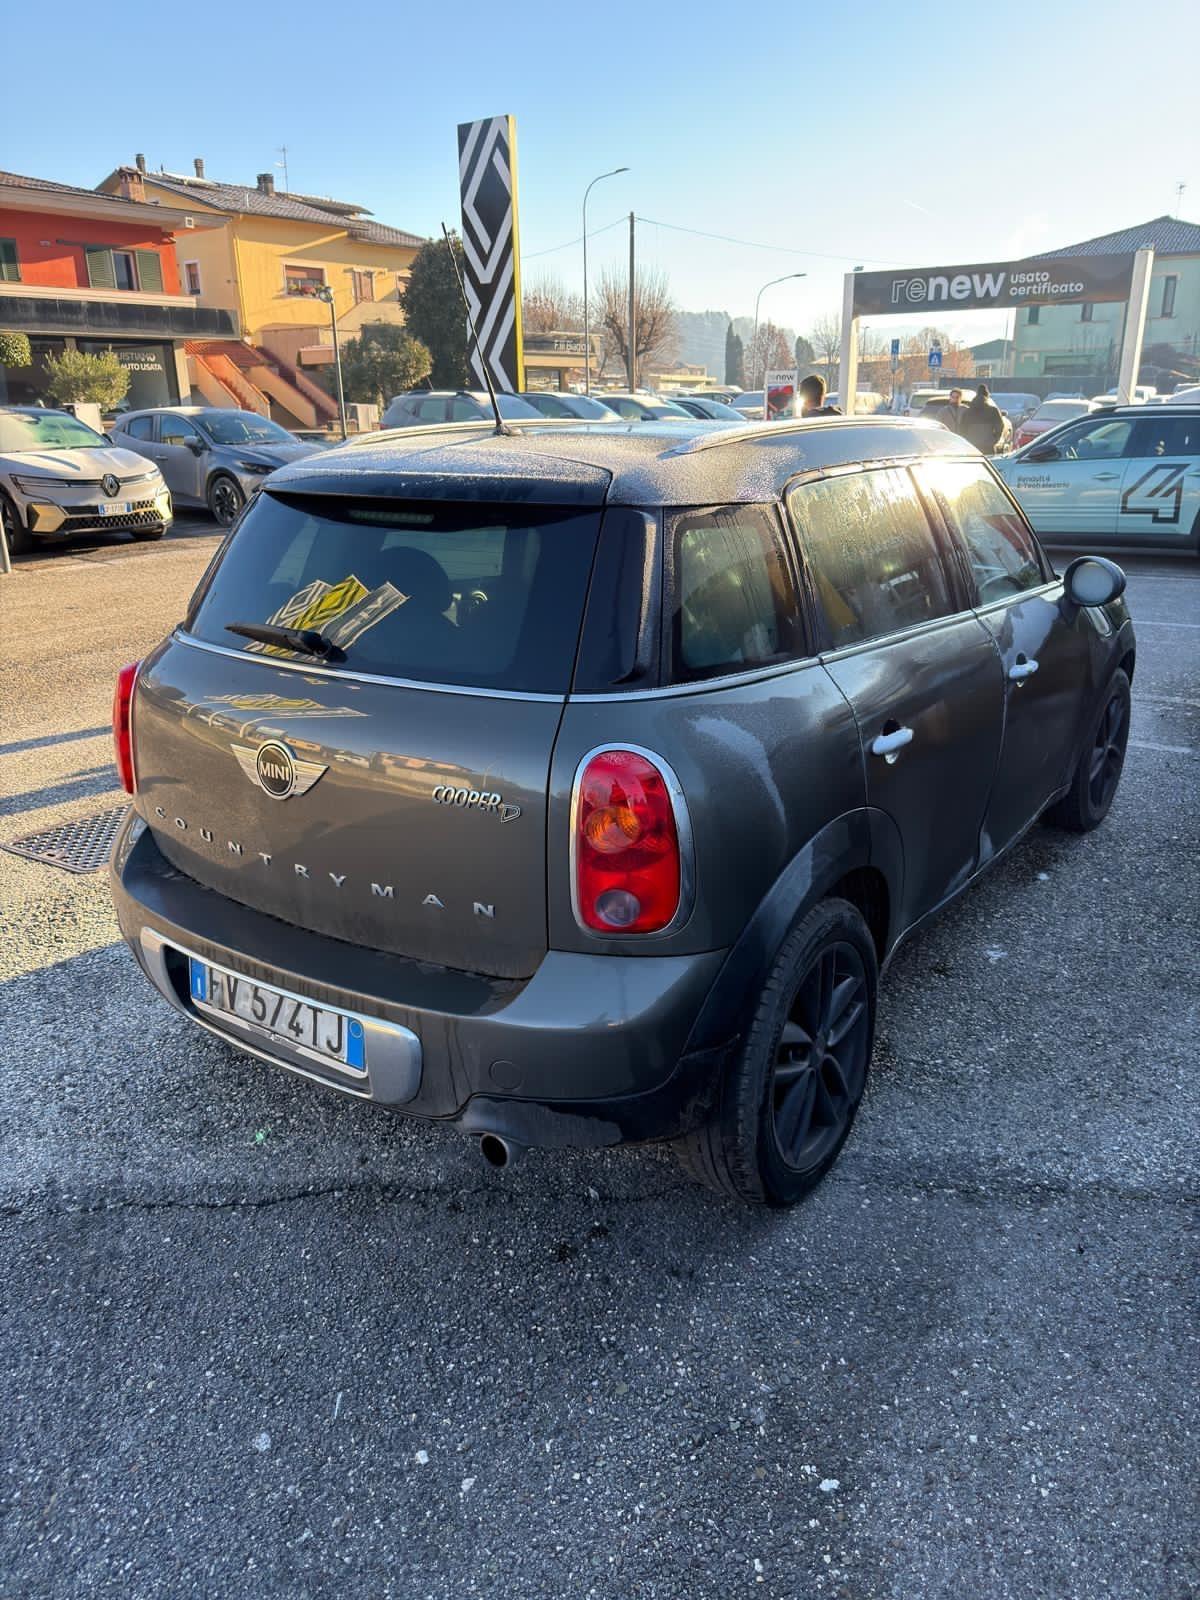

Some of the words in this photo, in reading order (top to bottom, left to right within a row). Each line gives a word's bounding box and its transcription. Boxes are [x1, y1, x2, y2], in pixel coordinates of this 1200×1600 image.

[891, 272, 1005, 303] renew
[1010, 271, 1050, 284] usato
[1009, 281, 1084, 297] certificato
[140, 363, 162, 371] USATA
[260, 760, 290, 780] MINI
[432, 785, 502, 812] COOPER
[155, 806, 495, 918] COUNTRYMAN
